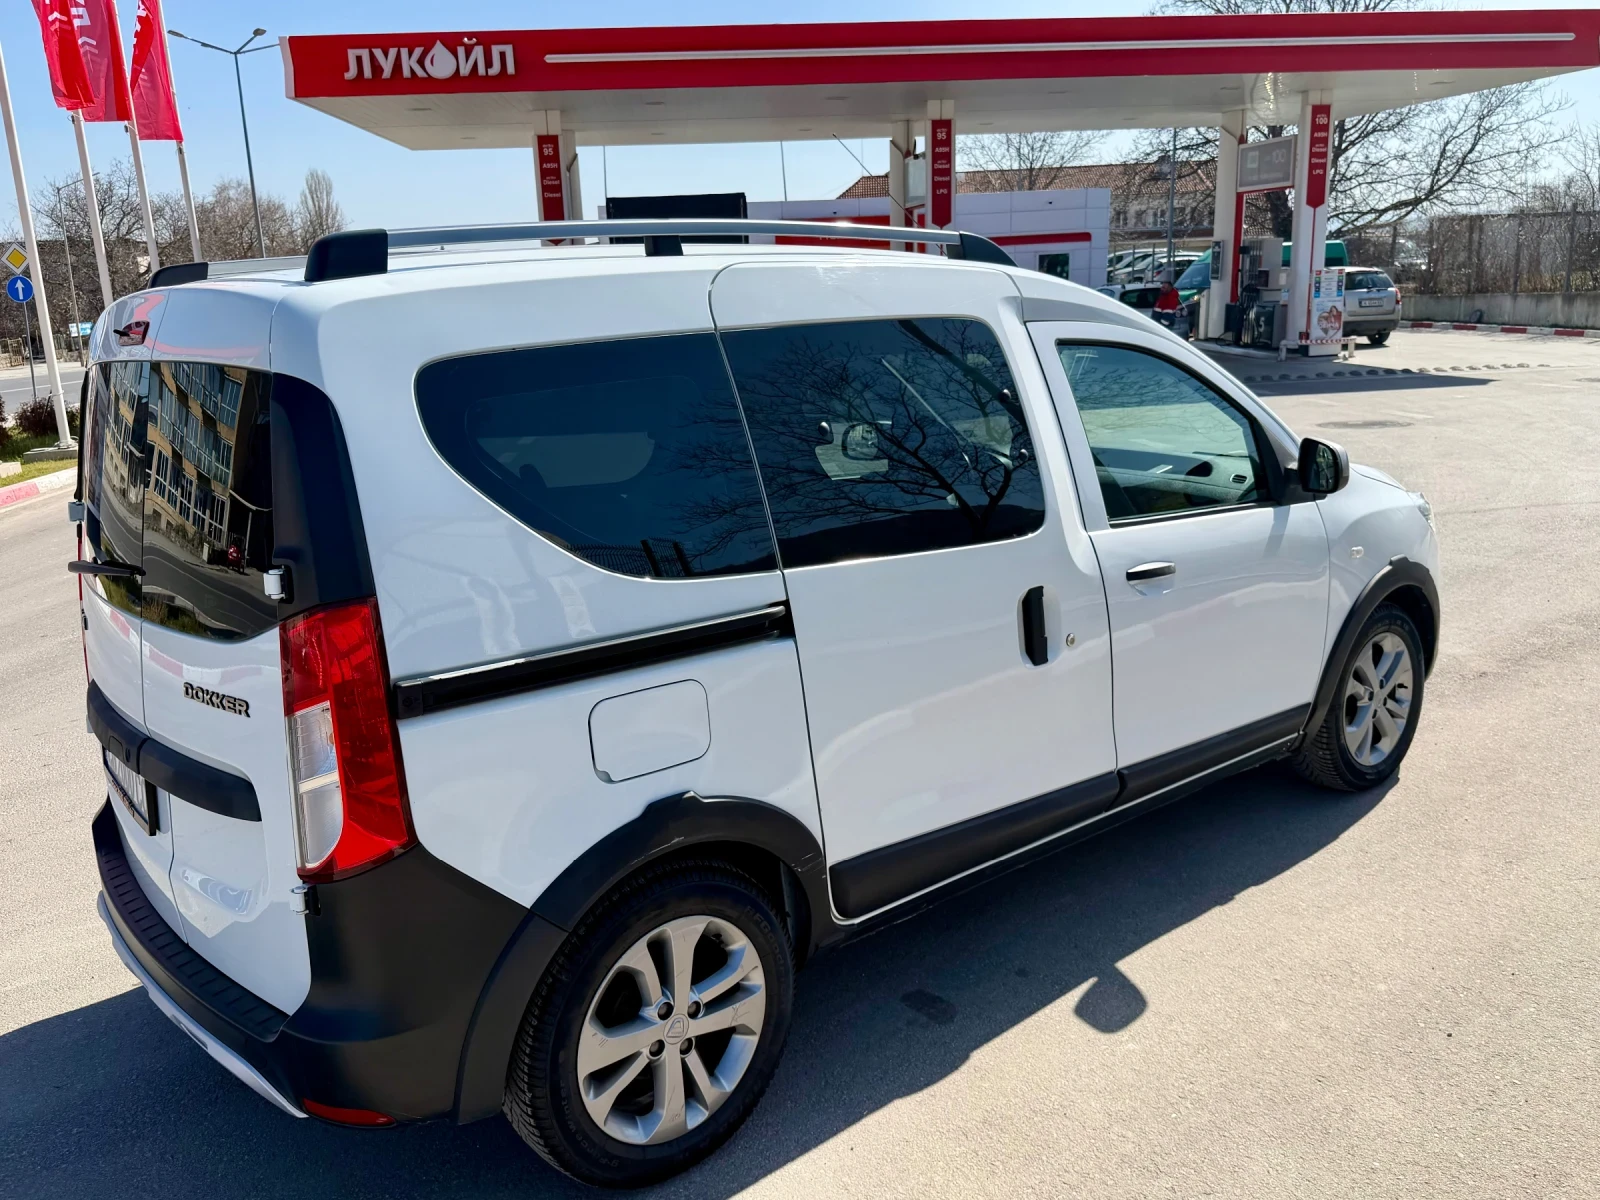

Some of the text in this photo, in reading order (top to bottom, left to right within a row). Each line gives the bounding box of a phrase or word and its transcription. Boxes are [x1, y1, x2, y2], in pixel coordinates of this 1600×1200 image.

[1315, 117, 1328, 125] 100
[936, 132, 947, 140] 95
[543, 148, 554, 156] 95
[183, 681, 251, 718] DOKKER
